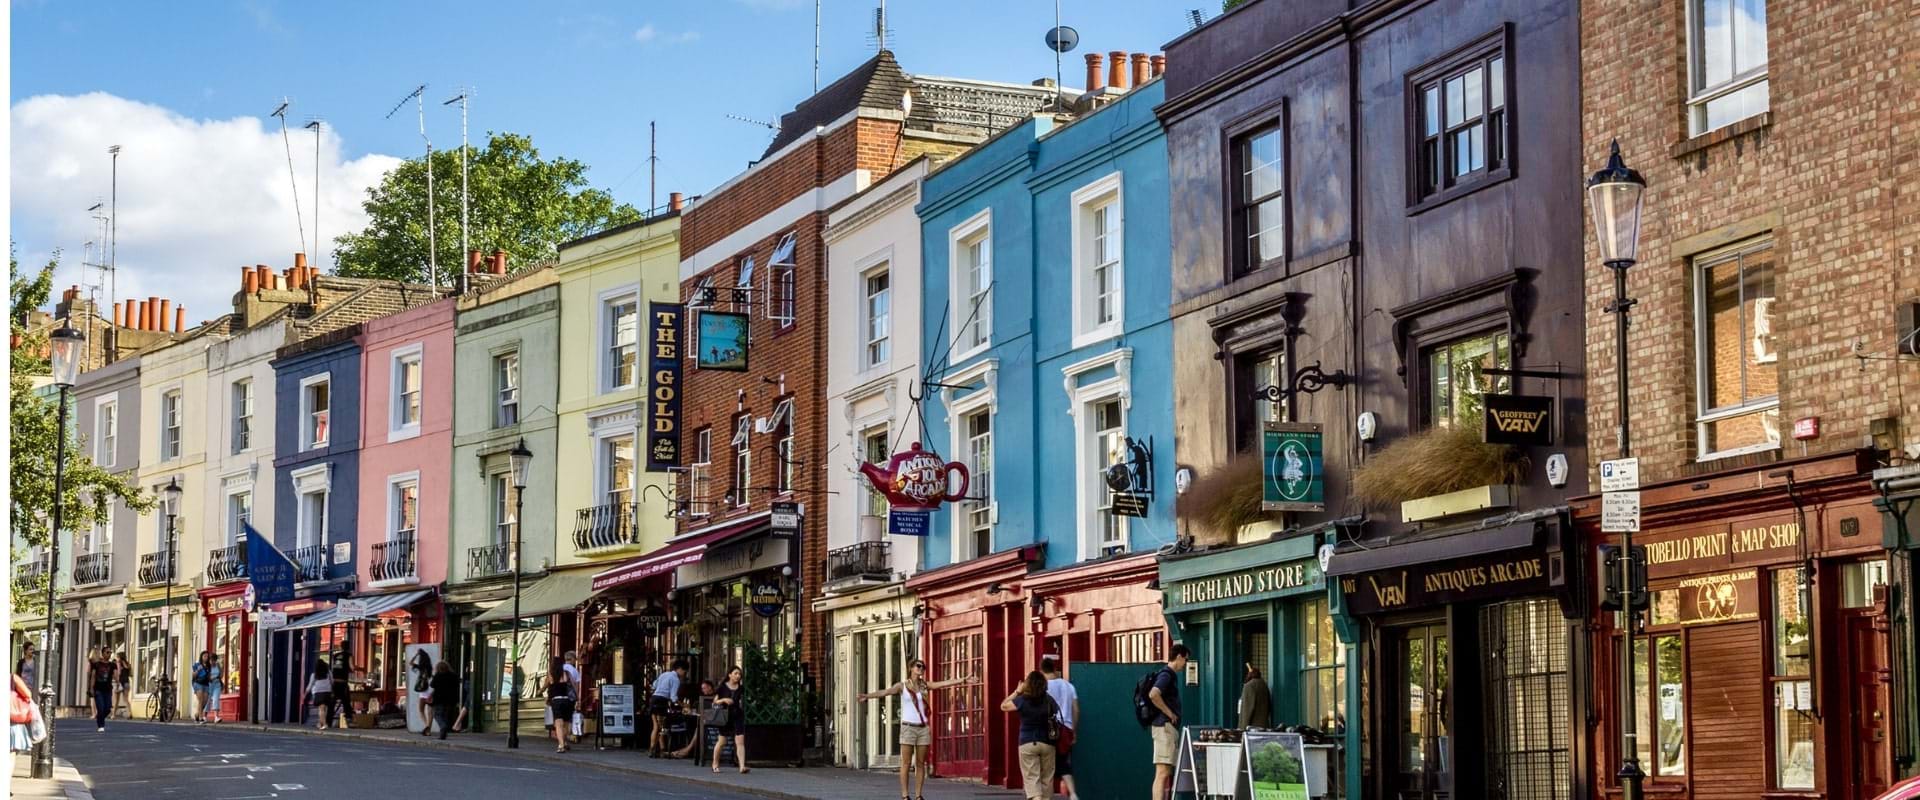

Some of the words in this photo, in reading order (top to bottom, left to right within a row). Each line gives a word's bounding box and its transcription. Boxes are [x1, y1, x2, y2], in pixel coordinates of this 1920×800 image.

[656, 312, 676, 359] THE
[654, 370, 675, 432] GOLD
[1499, 410, 1538, 419] GEOFFREY
[1489, 408, 1547, 432] VAN
[1604, 463, 1611, 477] P
[1645, 537, 1690, 565] TOBELLO
[1692, 532, 1728, 559] PRINT
[1732, 534, 1739, 553] &
[1741, 527, 1766, 552] MAP
[1770, 523, 1799, 548] SHOP
[1182, 574, 1253, 604] HIGHLAND
[1258, 565, 1304, 592] STORE
[1369, 571, 1407, 607] VAN
[1425, 566, 1487, 592] ANTIQUES
[1490, 559, 1543, 583] ARCADE
[1680, 576, 1707, 587] ANTIQUE
[1738, 570, 1757, 580] MAPS
[217, 600, 236, 609] Gallery
